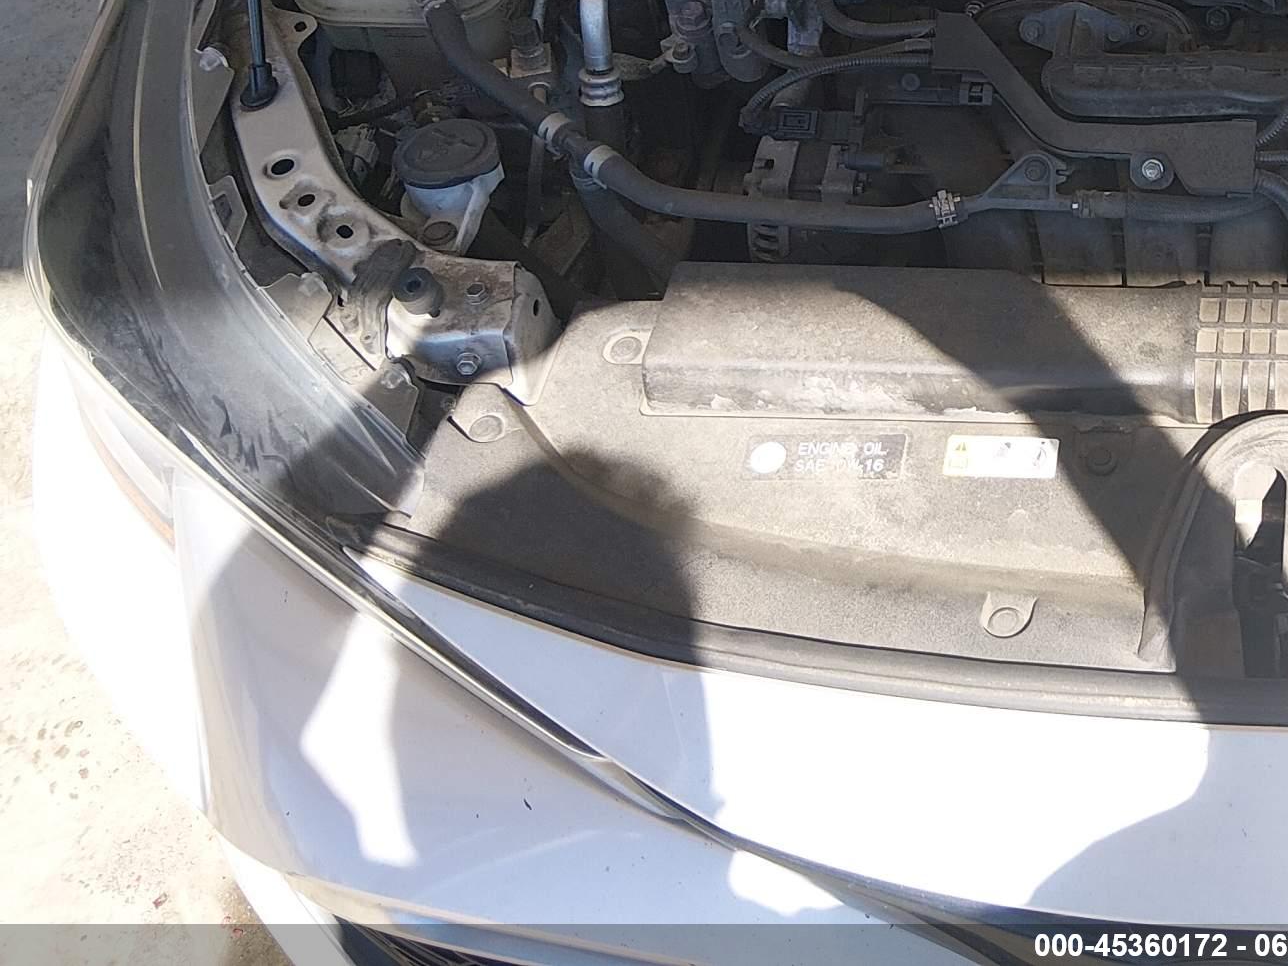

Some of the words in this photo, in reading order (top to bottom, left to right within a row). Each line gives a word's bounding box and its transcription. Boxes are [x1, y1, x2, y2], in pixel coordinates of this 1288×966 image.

[798, 441, 858, 456] ENGINE
[864, 441, 887, 456] OIL
[794, 458, 826, 473] SAE
